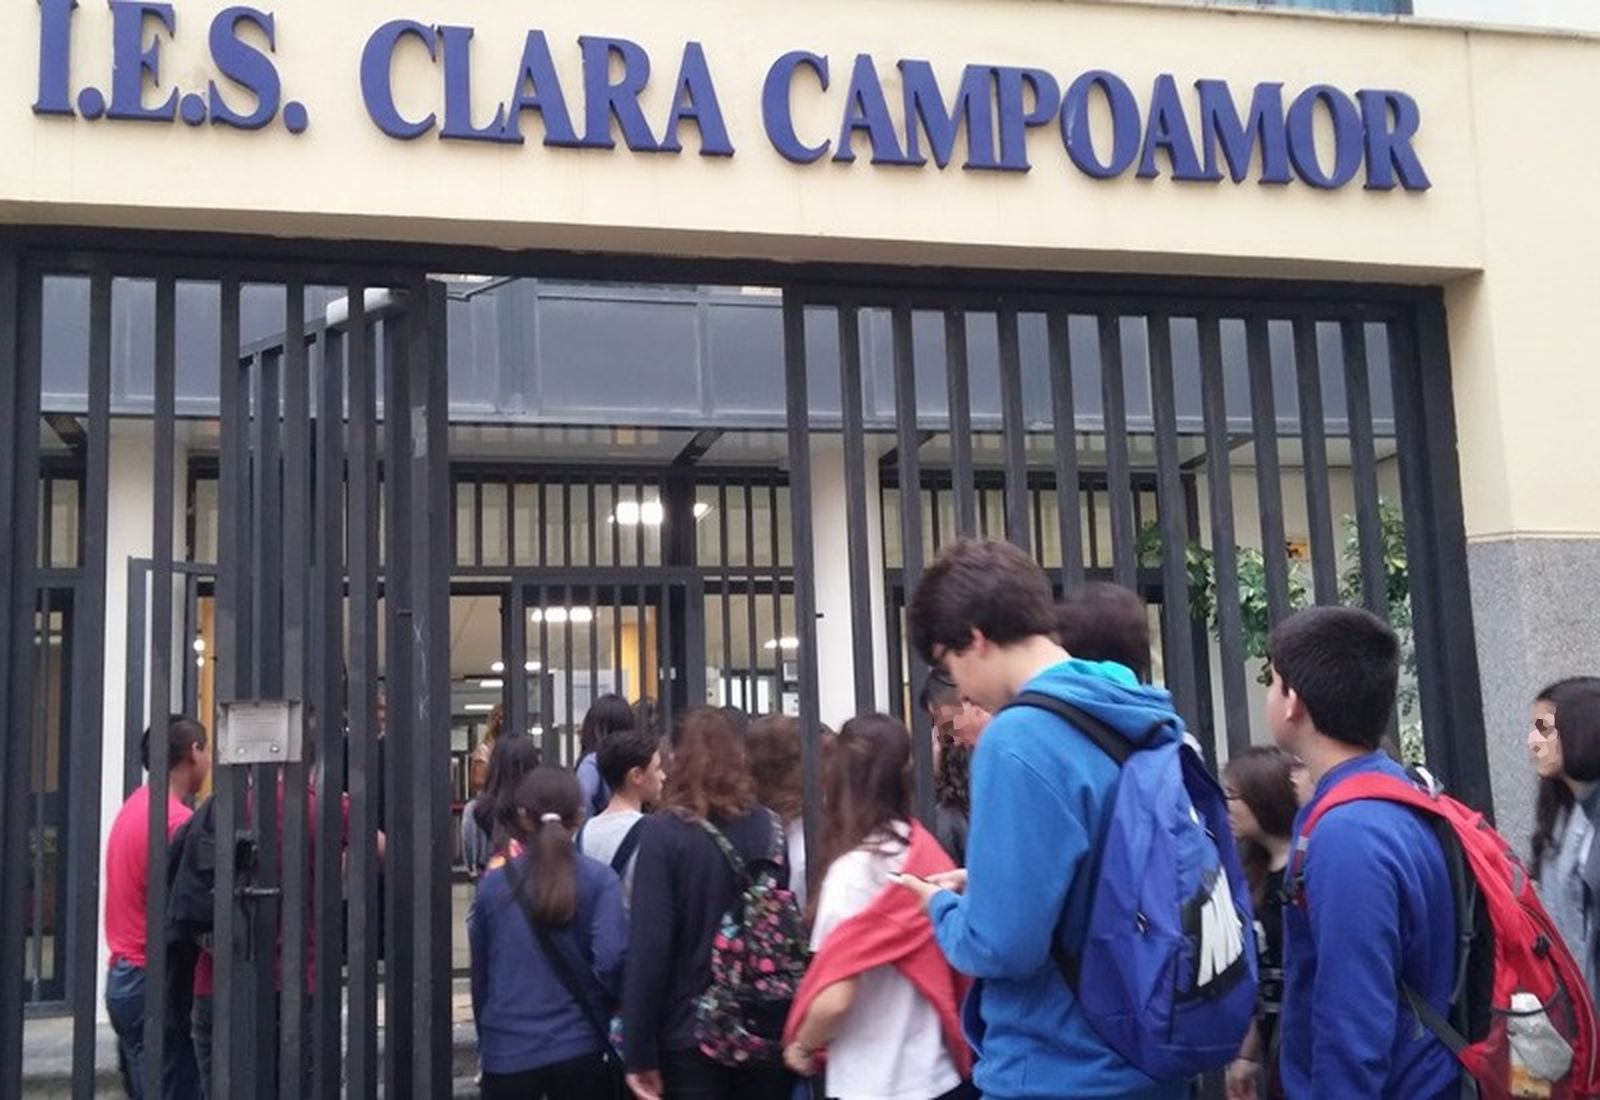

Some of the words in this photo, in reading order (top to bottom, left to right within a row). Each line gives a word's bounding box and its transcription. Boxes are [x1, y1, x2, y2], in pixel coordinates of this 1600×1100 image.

[33, 0, 308, 134] I.E.S.
[360, 20, 734, 157] CLARA
[762, 50, 1431, 193] CAMPOAMOR
